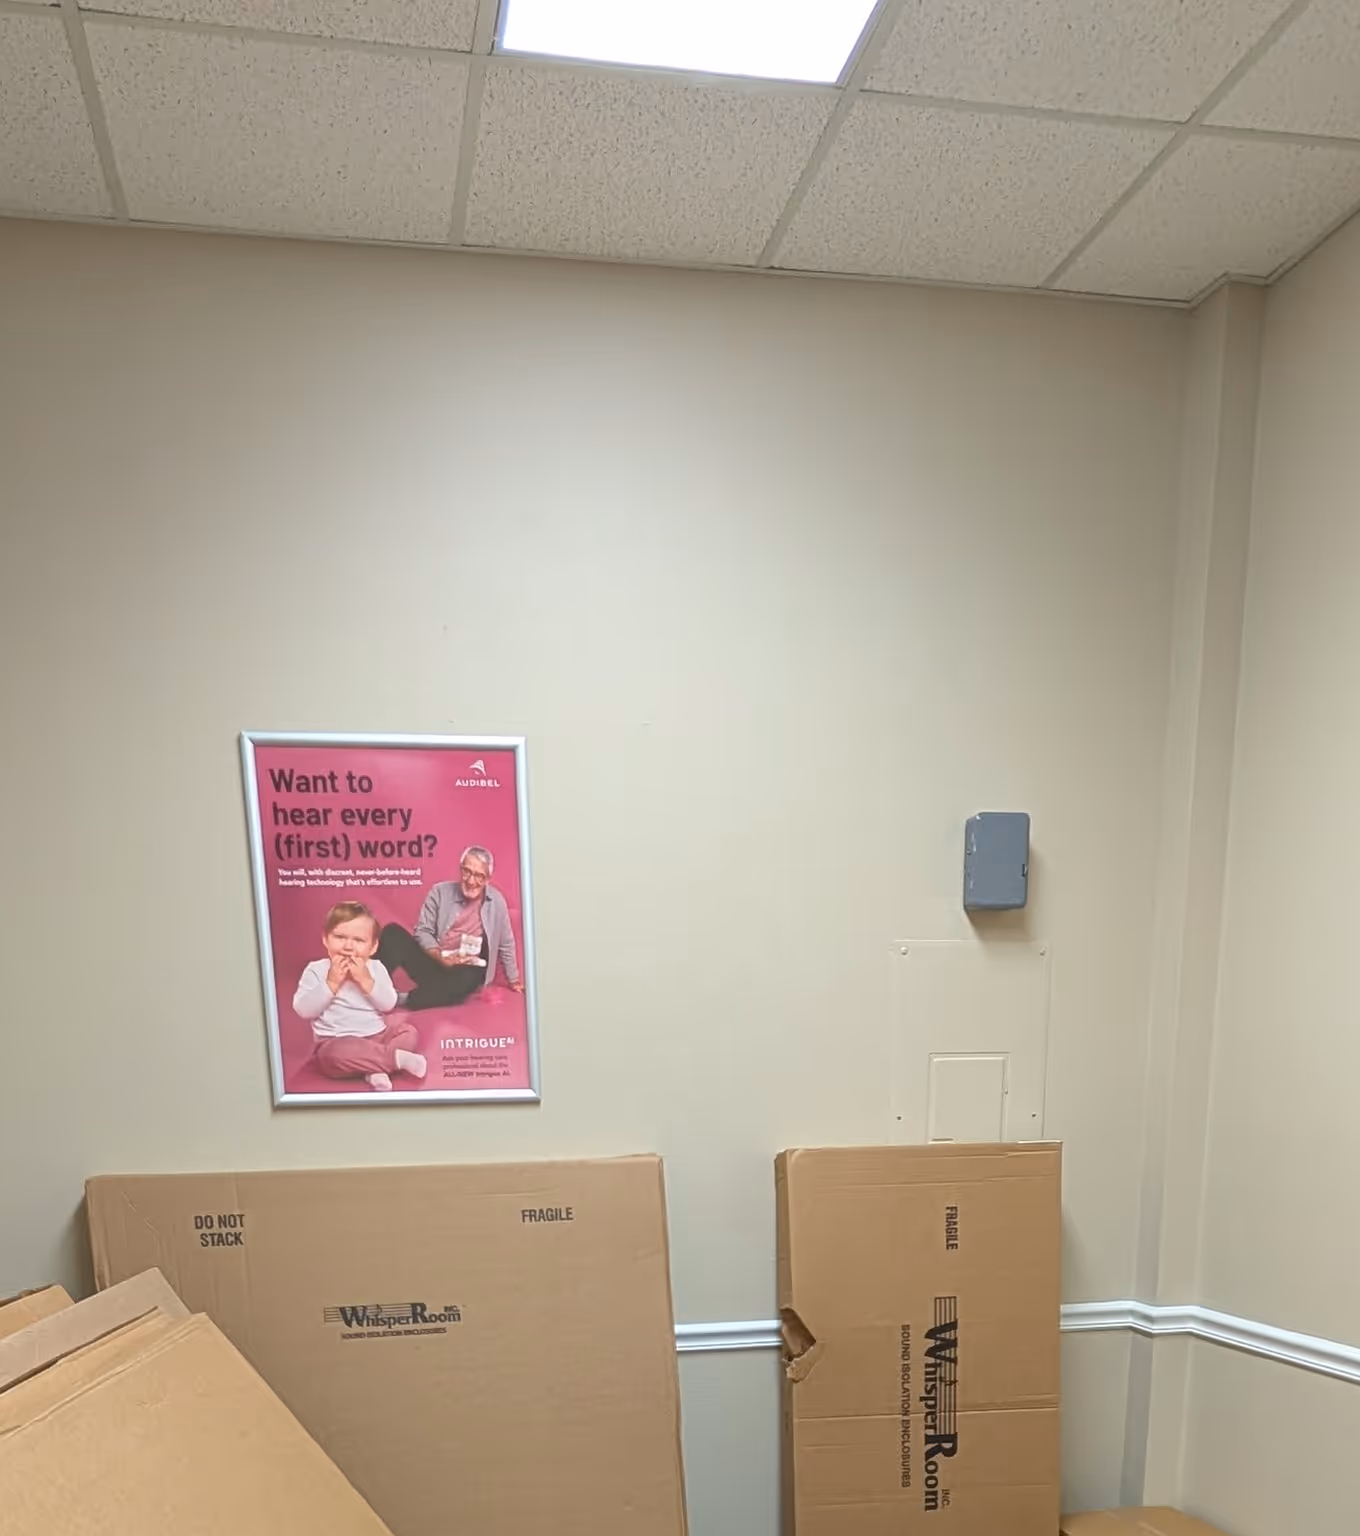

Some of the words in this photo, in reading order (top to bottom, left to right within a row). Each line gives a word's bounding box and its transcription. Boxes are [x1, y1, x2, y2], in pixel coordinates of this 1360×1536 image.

[269, 768, 339, 793] Want
[346, 770, 373, 793] to
[455, 779, 500, 787] AUDIBEL
[272, 802, 332, 826] hear
[341, 808, 413, 832] every
[275, 832, 350, 861] (first)
[357, 834, 438, 858] word?
[307, 878, 344, 887] technology
[194, 1214, 214, 1229] DO
[218, 1214, 245, 1229] NOT
[521, 1207, 574, 1223] FRAGILE
[946, 1206, 958, 1250] FRAGILE
[200, 1232, 244, 1247] STACK
[902, 1325, 910, 1361] SOUND
[902, 1363, 911, 1417] ISOLATION
[920, 1319, 958, 1511] WhisperRoom
[941, 1489, 950, 1508] INC.
[902, 1420, 911, 1488] ENCLOSURES
